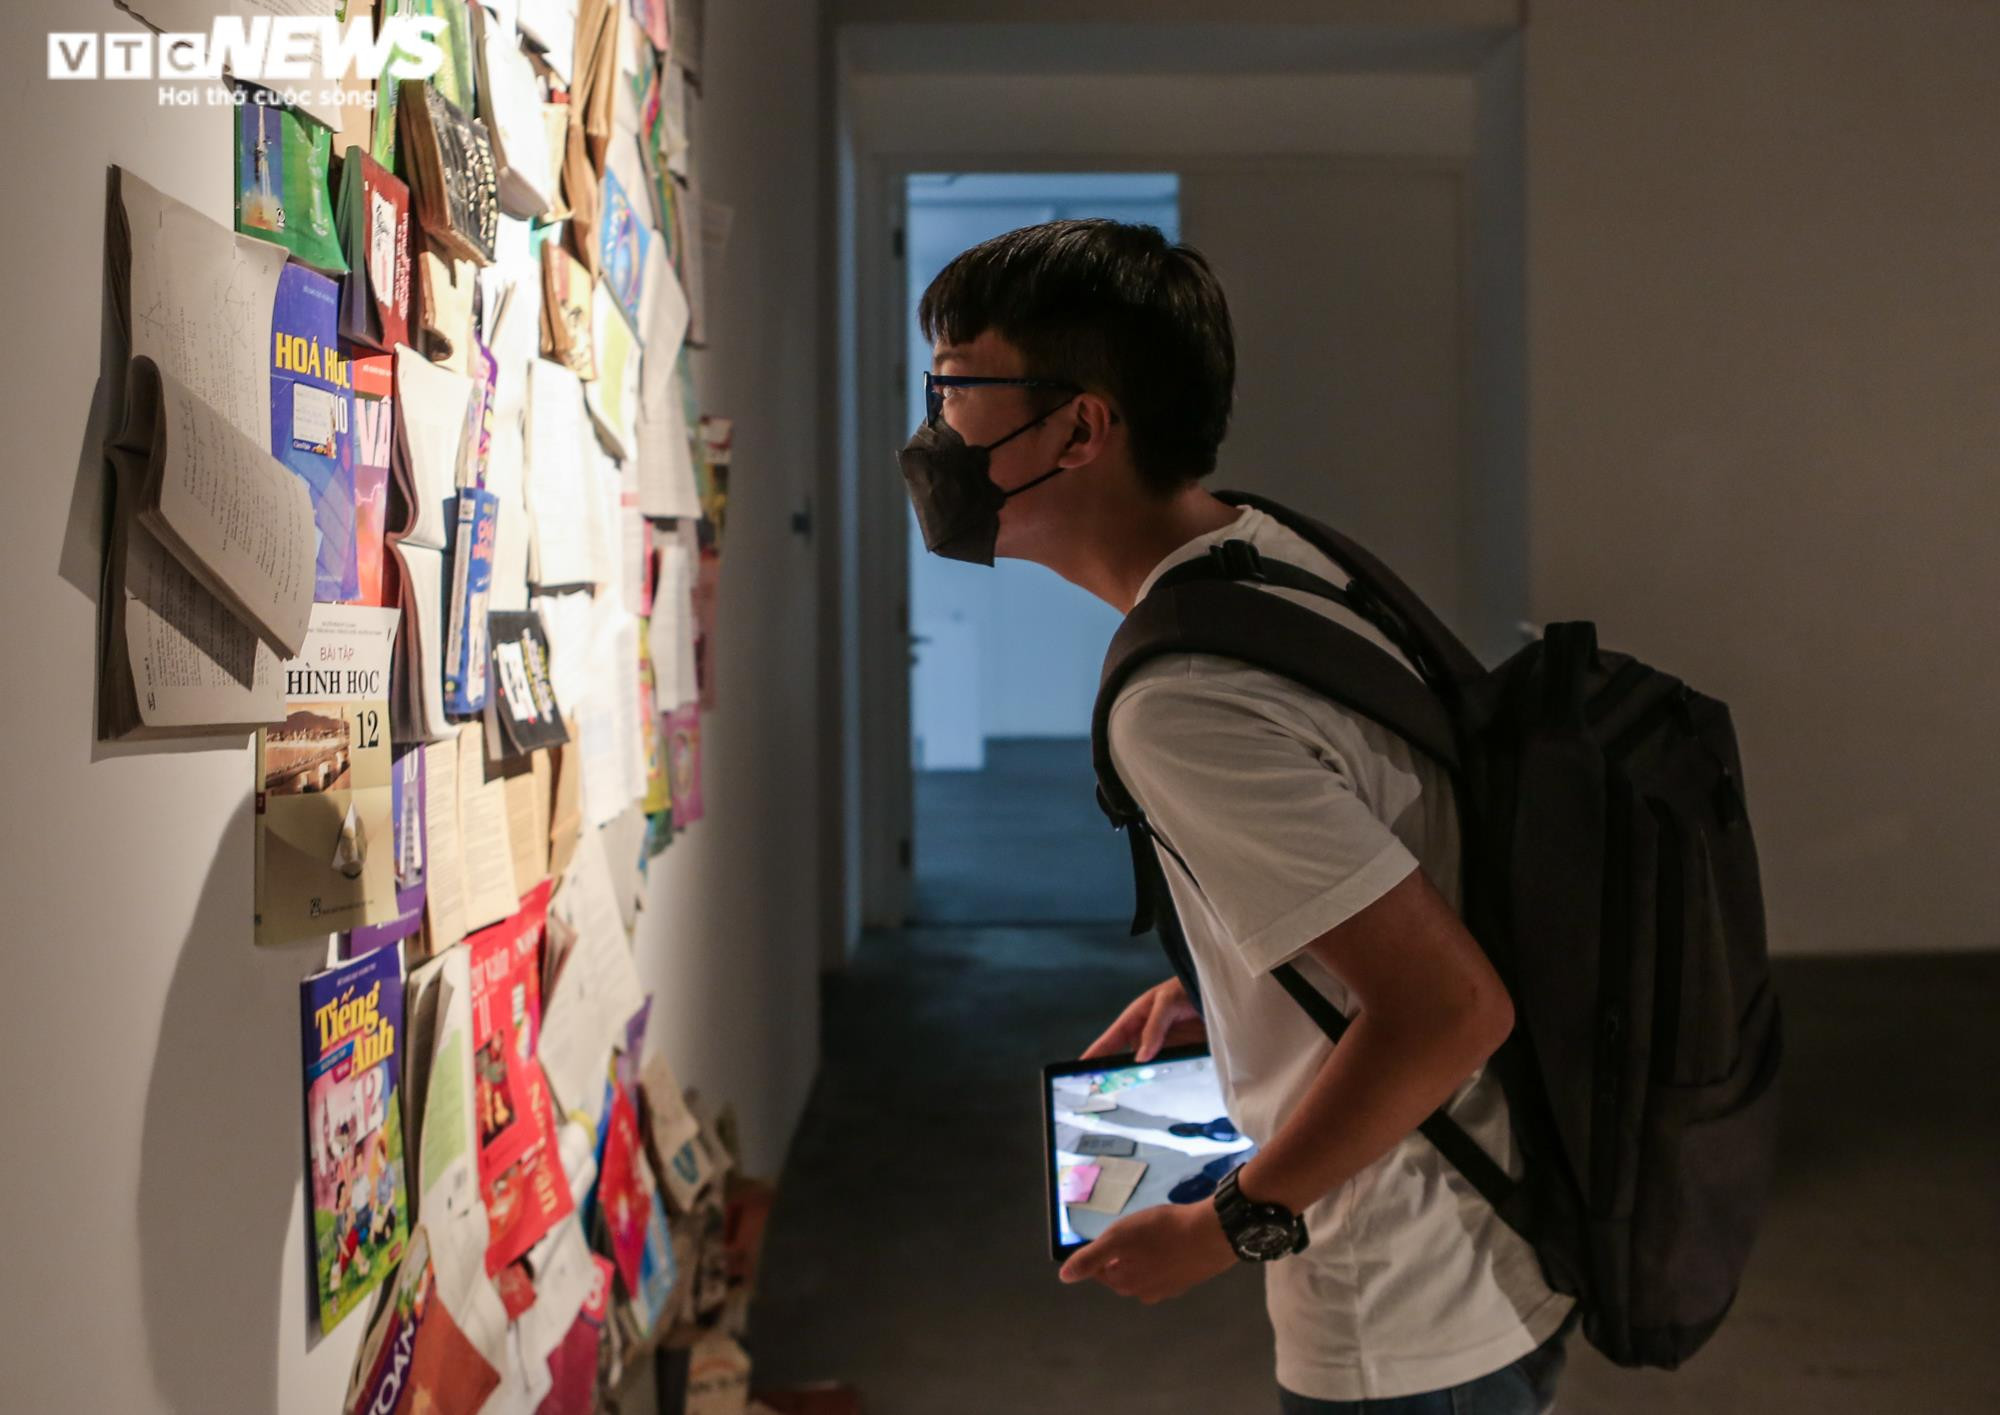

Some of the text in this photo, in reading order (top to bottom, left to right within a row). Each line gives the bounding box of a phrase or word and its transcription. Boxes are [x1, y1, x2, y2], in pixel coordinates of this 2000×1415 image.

[275, 332, 351, 390] HOÁ HỌC
[320, 645, 336, 661] BÀI
[286, 661, 380, 700] HÌNH HỌC
[356, 710, 380, 749] 12
[315, 979, 382, 1052] Tiếng
[351, 1016, 395, 1082] Anh
